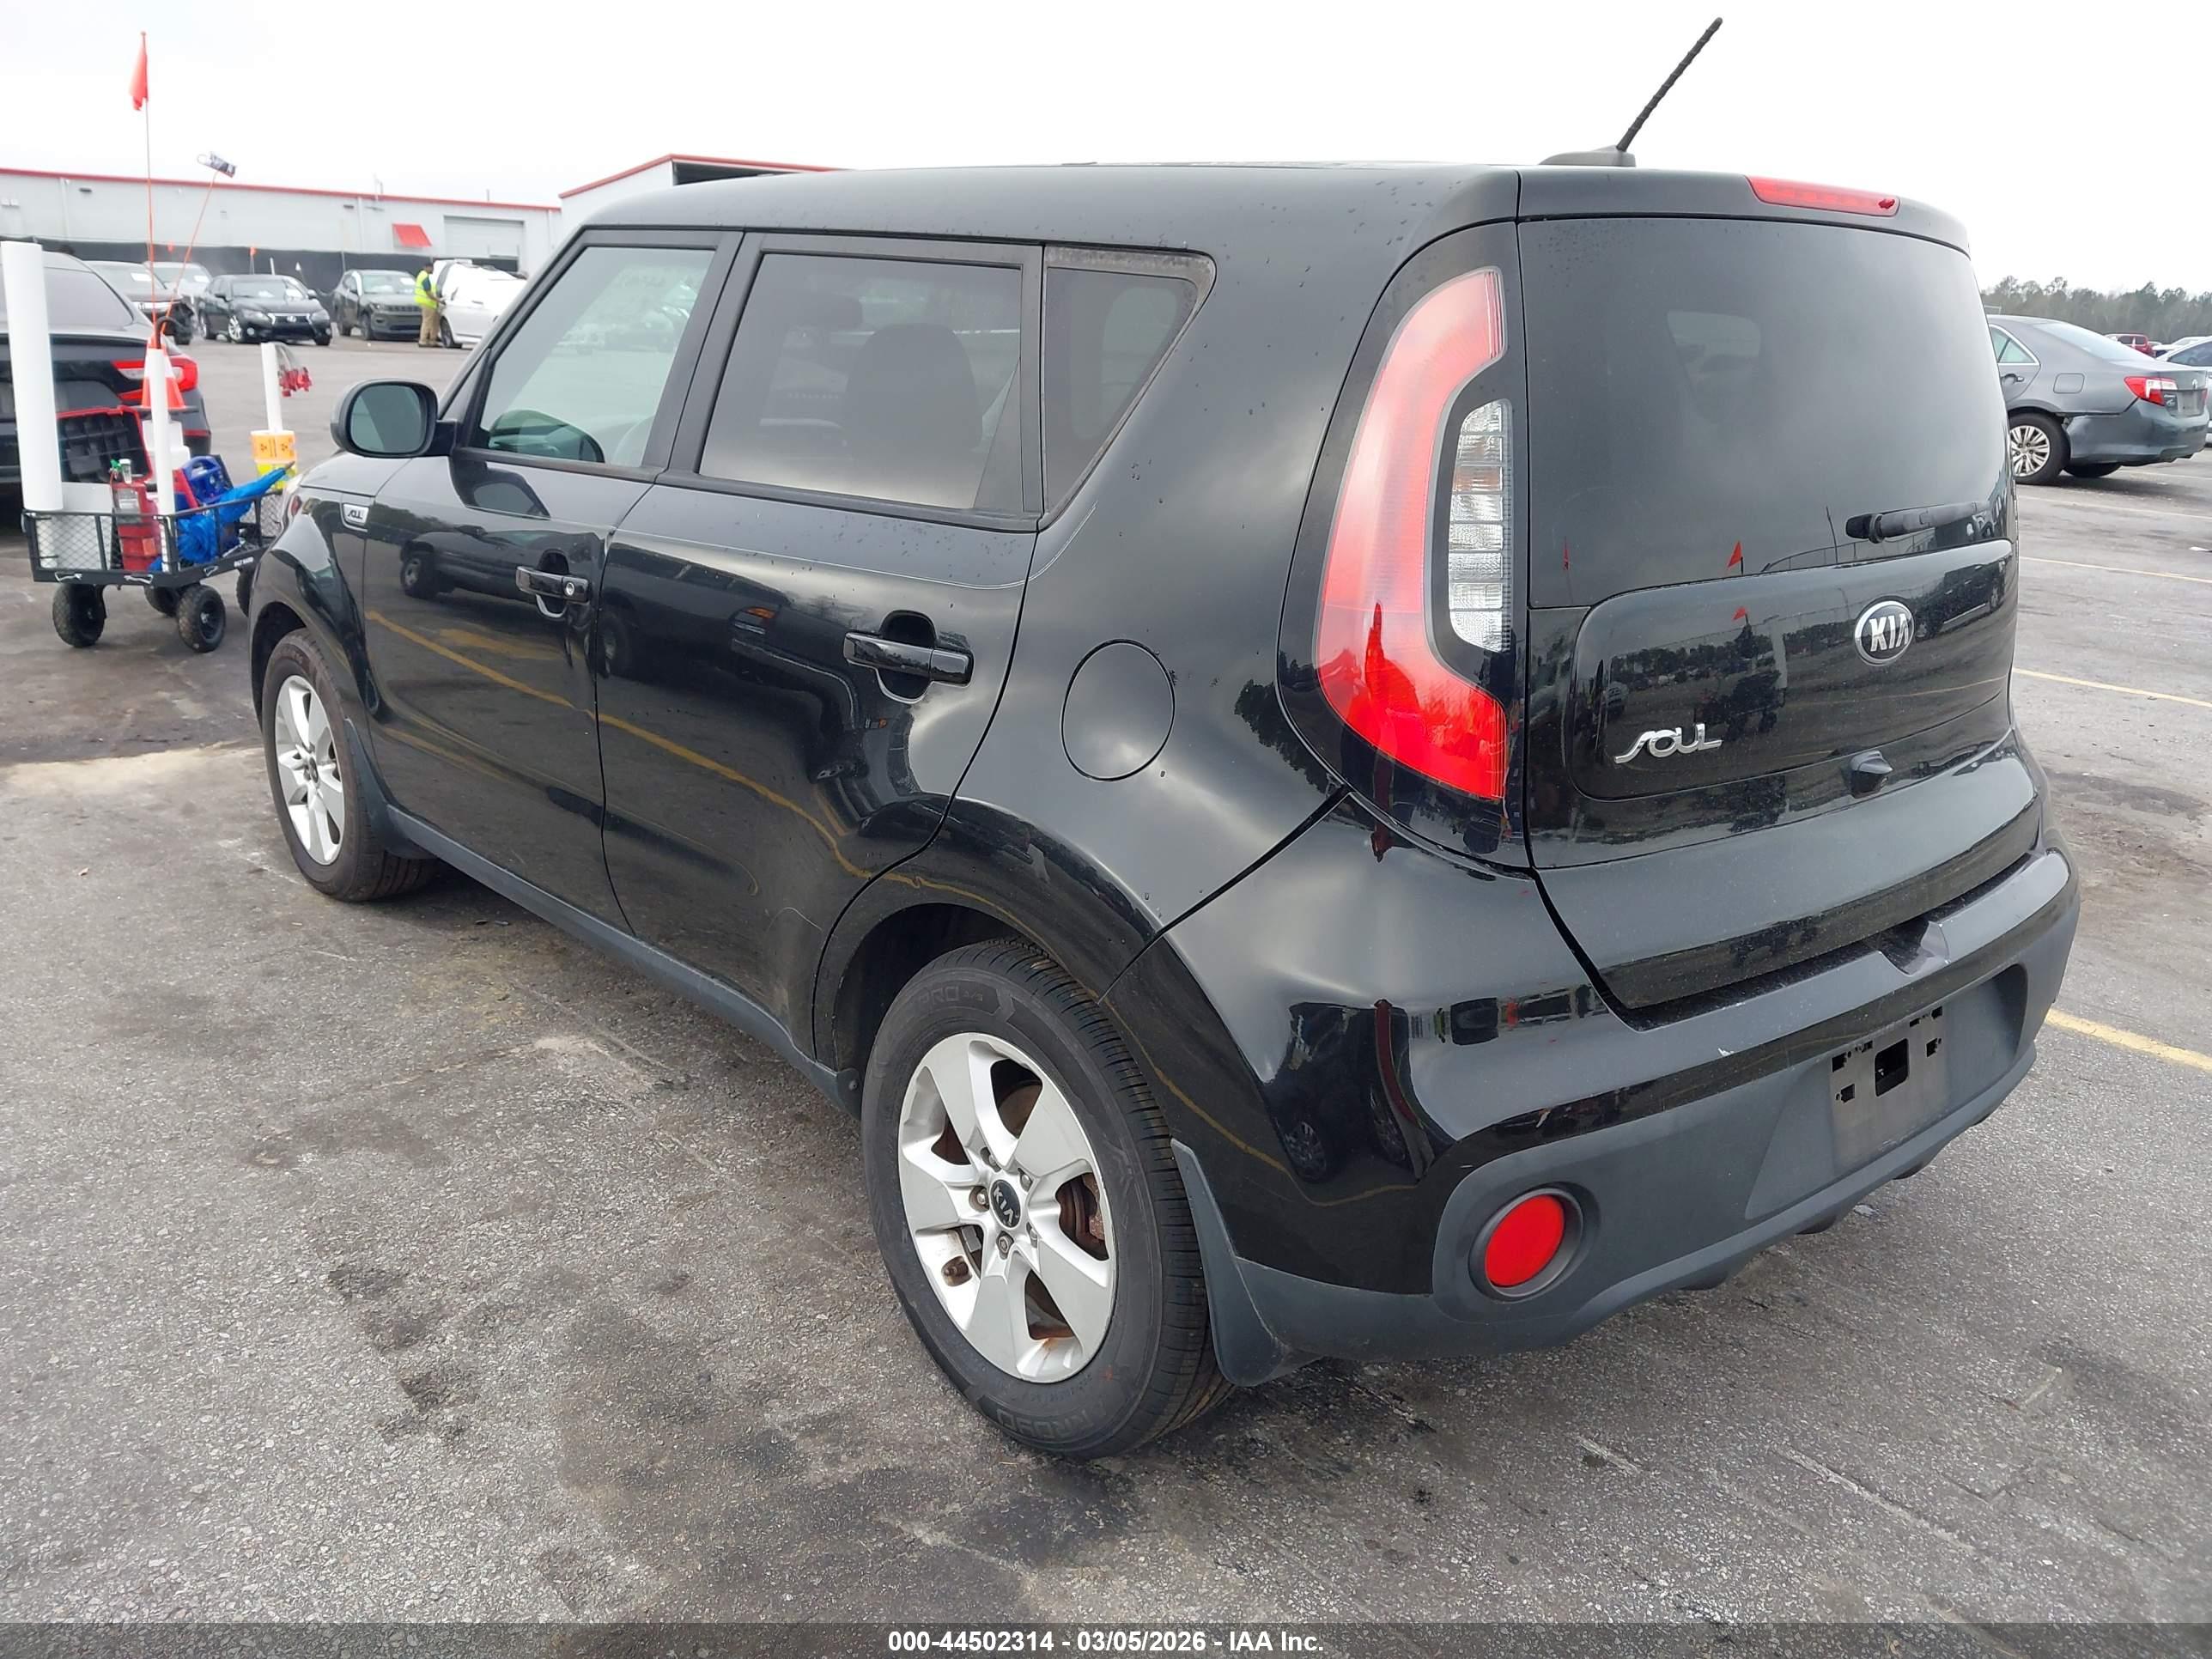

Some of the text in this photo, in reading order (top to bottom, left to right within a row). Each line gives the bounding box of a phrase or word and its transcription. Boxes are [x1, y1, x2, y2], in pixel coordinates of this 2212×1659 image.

[1869, 613, 1909, 652] KIA
[1614, 723, 1723, 763] SOUL
[994, 1186, 1013, 1224] KIA
